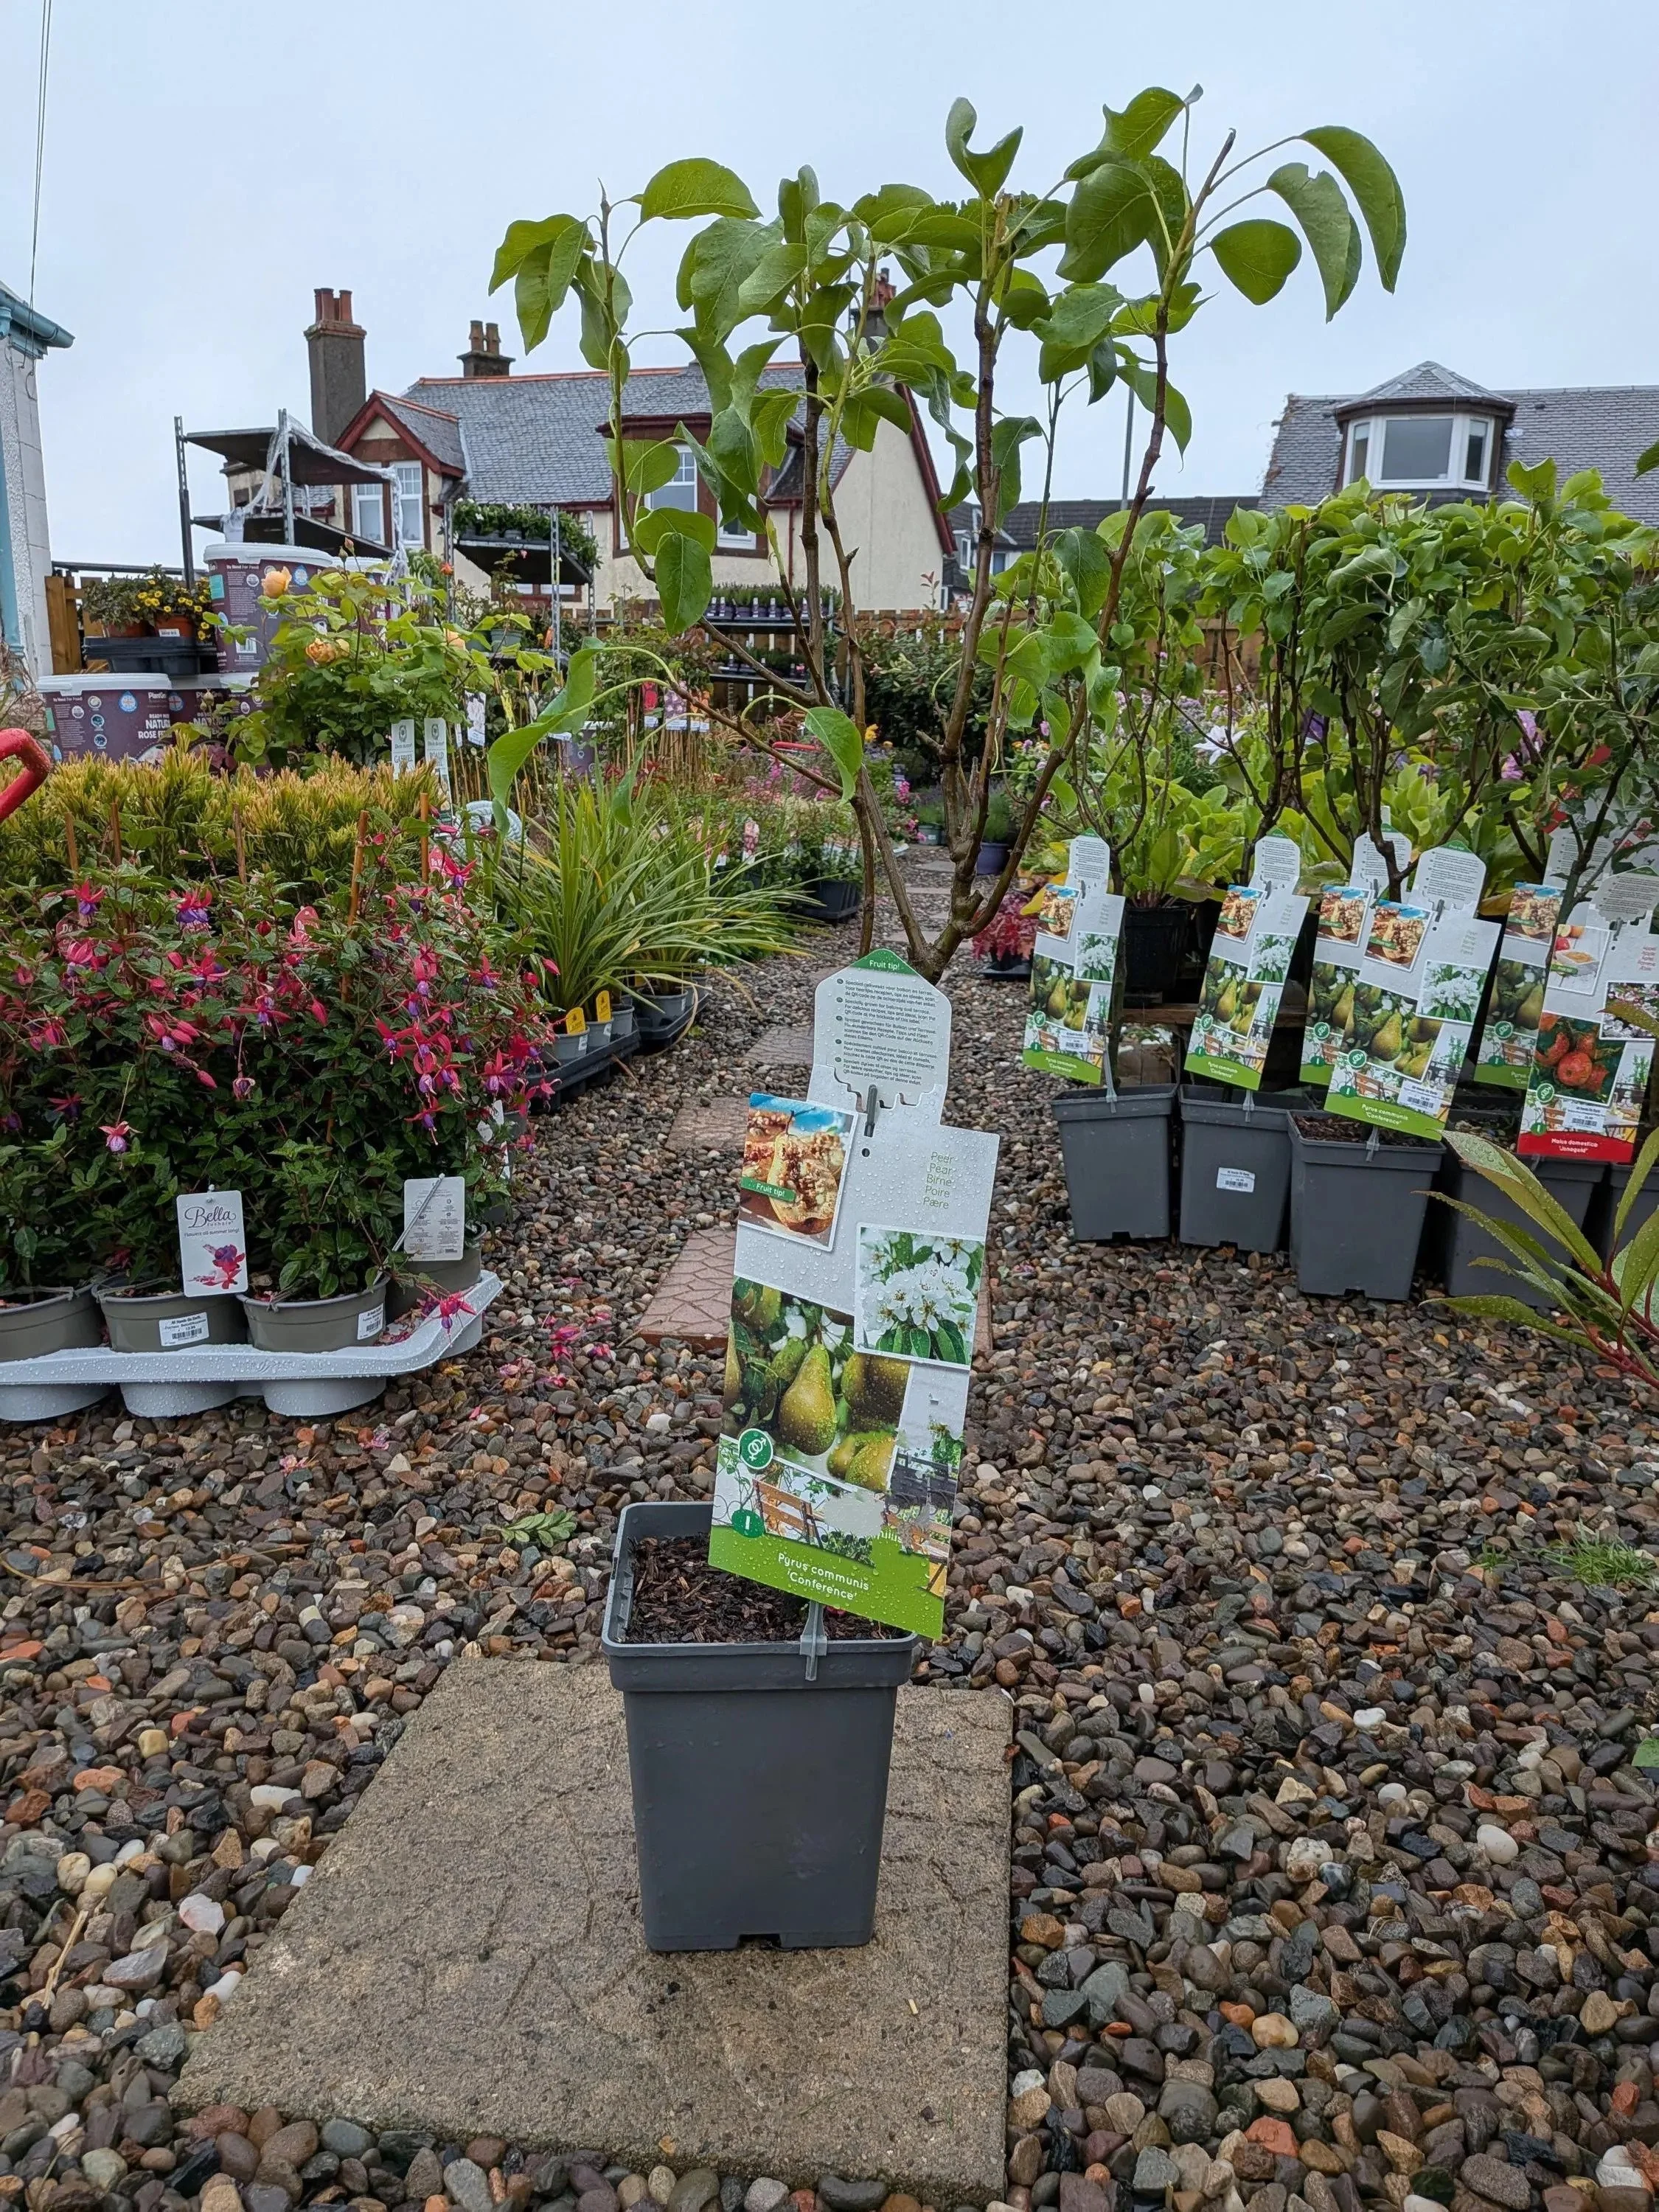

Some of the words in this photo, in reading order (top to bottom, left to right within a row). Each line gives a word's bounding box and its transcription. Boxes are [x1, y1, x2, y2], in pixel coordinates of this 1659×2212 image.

[138, 731, 156, 739] ROSE
[869, 959, 886, 968] Fruit
[888, 961, 900, 970] tip!
[931, 1152, 954, 1164] Peer
[929, 1163, 952, 1175] Pear
[927, 1174, 951, 1186] Birne
[757, 1183, 772, 1193] Fruit
[774, 1189, 785, 1197] tip!
[925, 1185, 950, 1197] Poire
[923, 1197, 949, 1208] Pære
[184, 1206, 236, 1228] Bella
[778, 1553, 808, 1571] Pyrus
[811, 1566, 869, 1590] communis
[787, 1569, 857, 1600] 'Conference'
